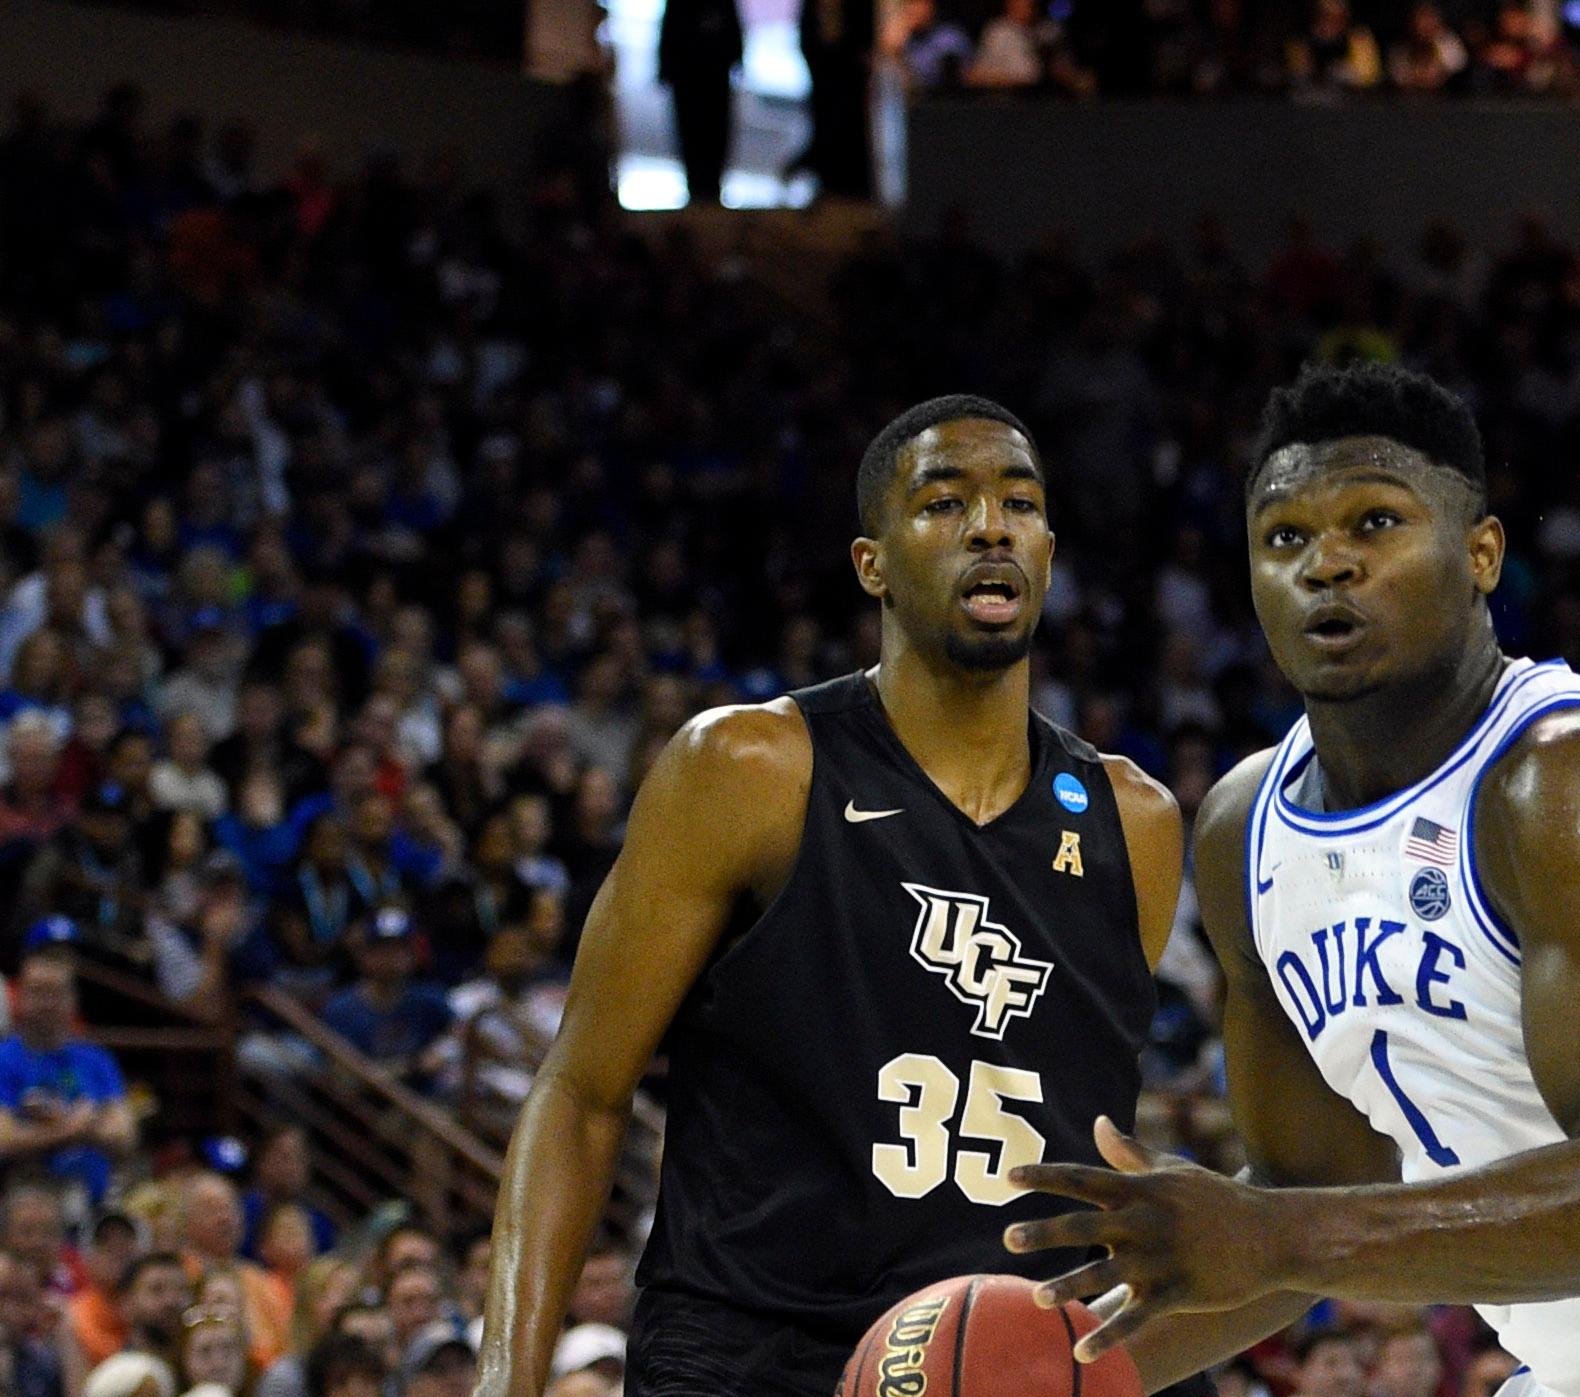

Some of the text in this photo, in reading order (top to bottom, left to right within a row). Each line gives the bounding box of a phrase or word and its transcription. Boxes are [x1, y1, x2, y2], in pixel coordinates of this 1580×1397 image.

[905, 884, 1051, 1038] UCF
[1413, 883, 1447, 900] ACC
[1276, 917, 1468, 1042] DUKE
[872, 1053, 1047, 1207] 35
[1370, 1029, 1461, 1168] 1
